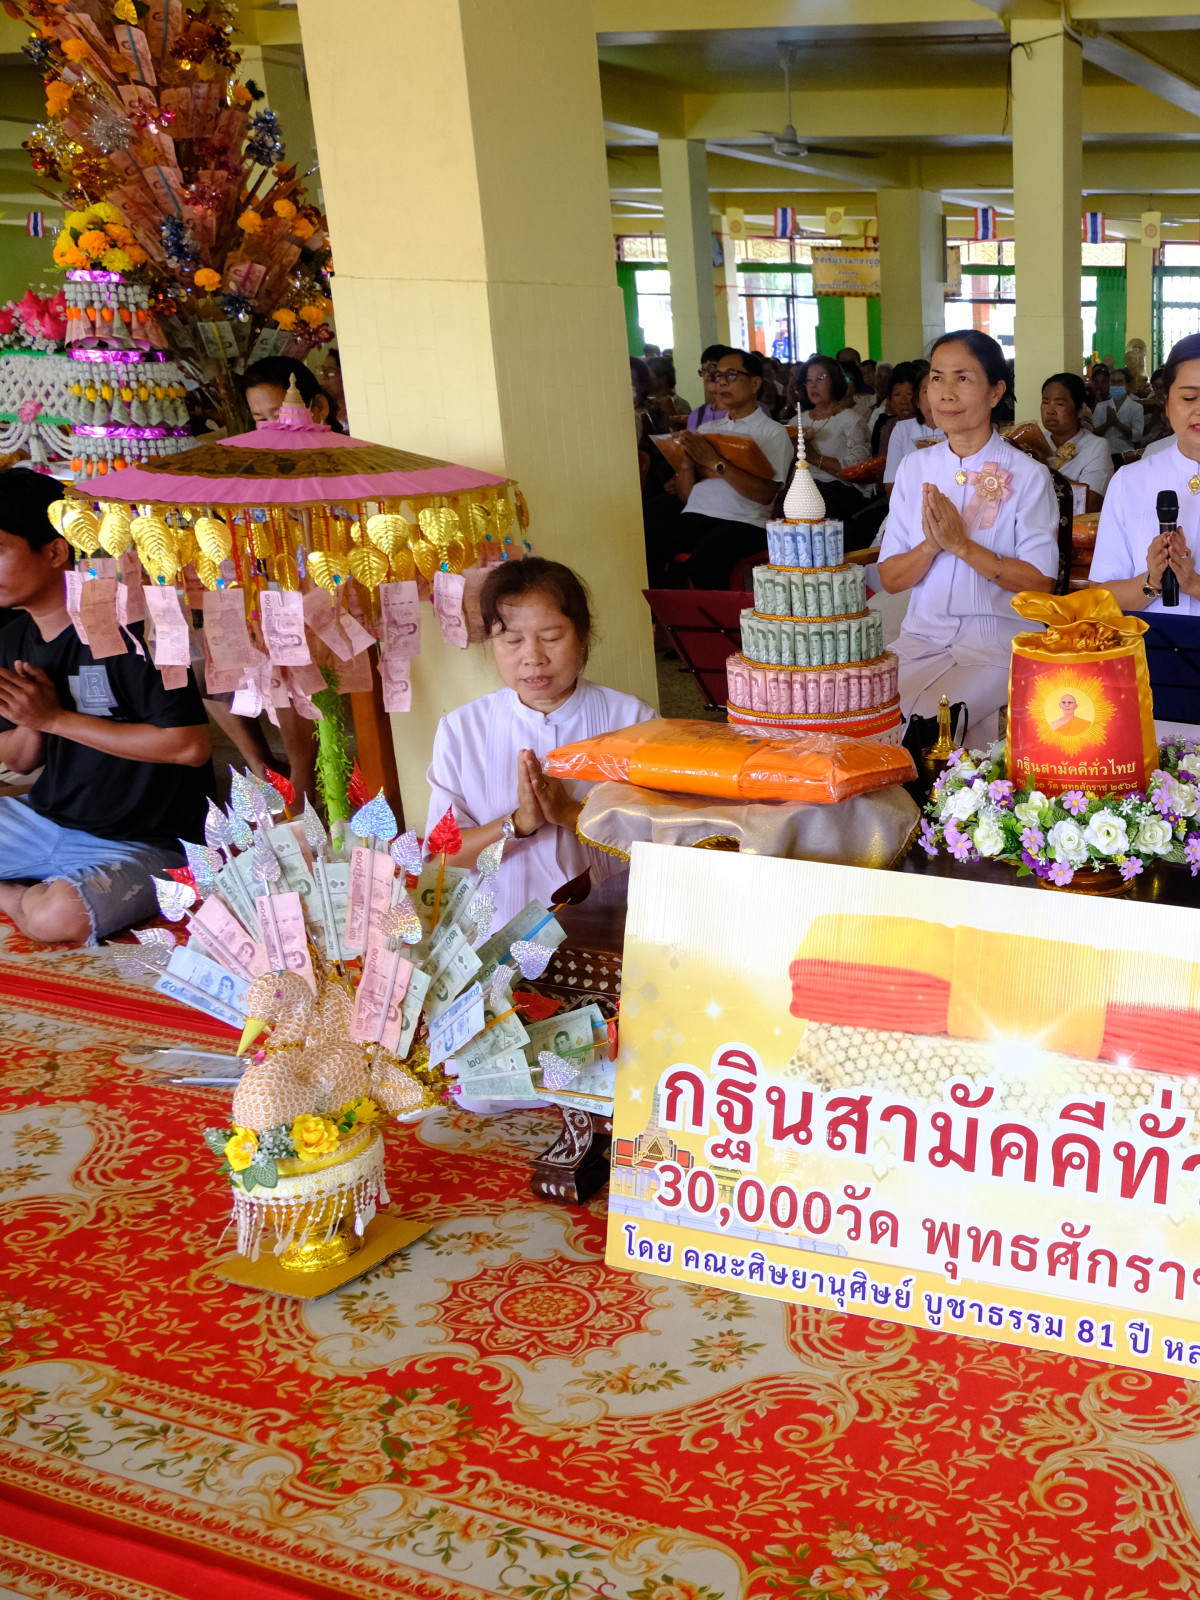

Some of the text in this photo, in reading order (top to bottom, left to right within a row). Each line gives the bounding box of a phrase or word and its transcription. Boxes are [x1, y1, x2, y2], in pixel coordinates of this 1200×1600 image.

[1017, 756, 1136, 775] กฐินสามัคคีทั่วไทย
[1061, 782, 1108, 791] พทธศักราช
[1110, 781, 1138, 790] ๒๕๖๘
[658, 1165, 899, 1248] 30,000วัด
[623, 1225, 672, 1263] โดย
[684, 1249, 912, 1309] คณะศิษยานุศิษย์
[924, 1293, 1064, 1338] บูชาธรรม
[1077, 1320, 1114, 1348] 81
[1128, 1322, 1151, 1354] ปี
